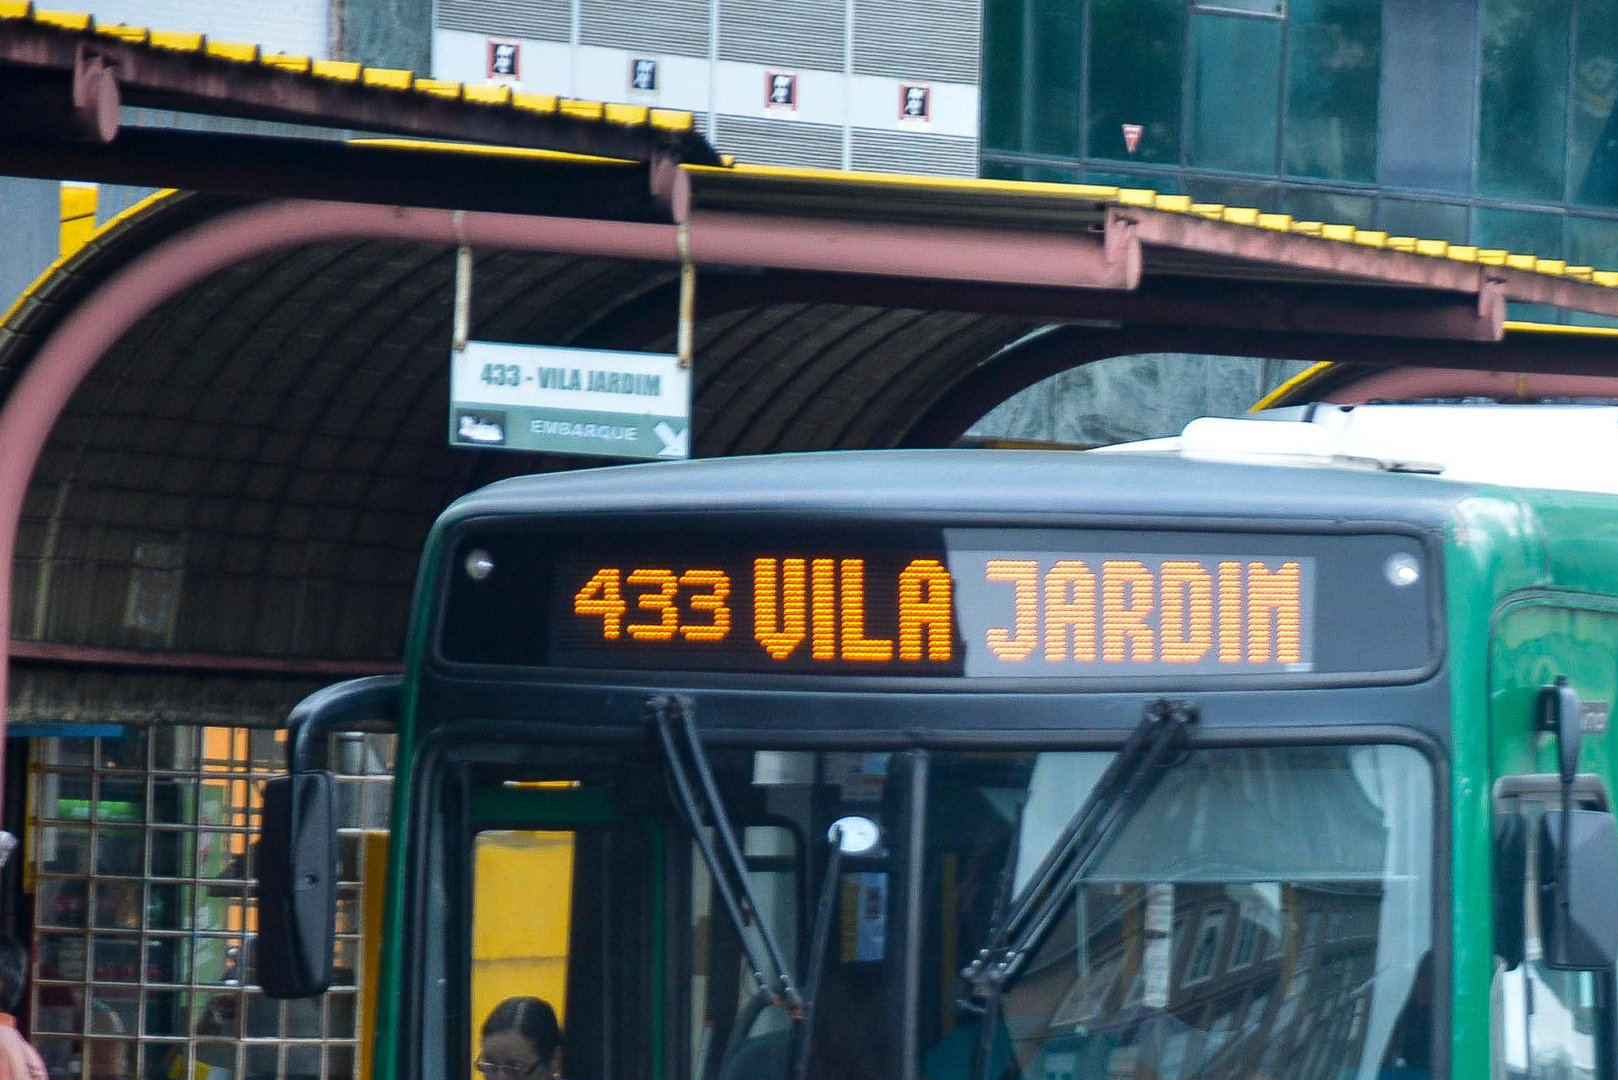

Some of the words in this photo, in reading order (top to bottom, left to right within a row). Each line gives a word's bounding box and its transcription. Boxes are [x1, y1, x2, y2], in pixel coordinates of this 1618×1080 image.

[481, 363, 521, 387] 433
[538, 366, 582, 392] VILA
[586, 370, 661, 397] JARDIM
[530, 419, 639, 441] EMBARQUE
[574, 567, 731, 642] 433
[753, 557, 952, 662] VILA
[985, 559, 1302, 664] JARDIM
